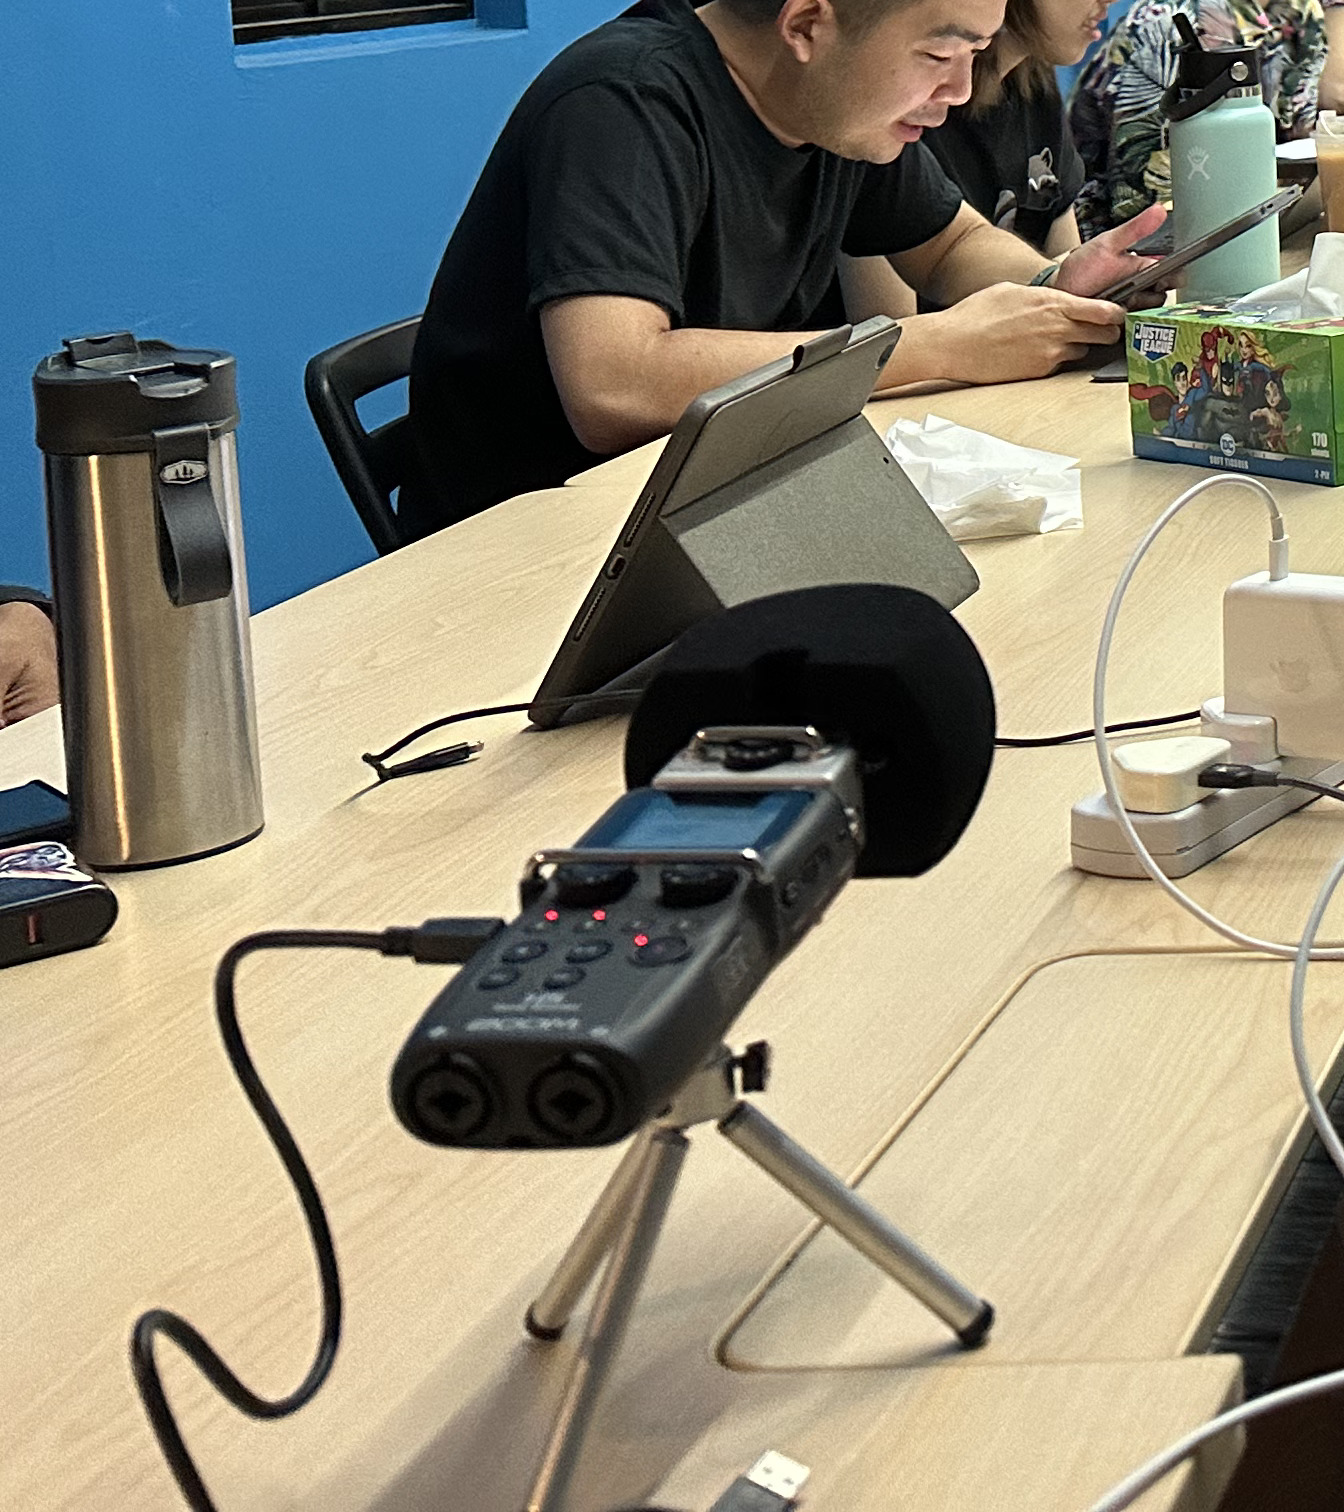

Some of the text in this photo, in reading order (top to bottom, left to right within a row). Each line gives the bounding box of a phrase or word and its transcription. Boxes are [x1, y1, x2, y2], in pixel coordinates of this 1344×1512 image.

[1135, 323, 1176, 341] JUSTICE
[1140, 338, 1174, 356] LEAGUE
[1311, 432, 1328, 448] 170
